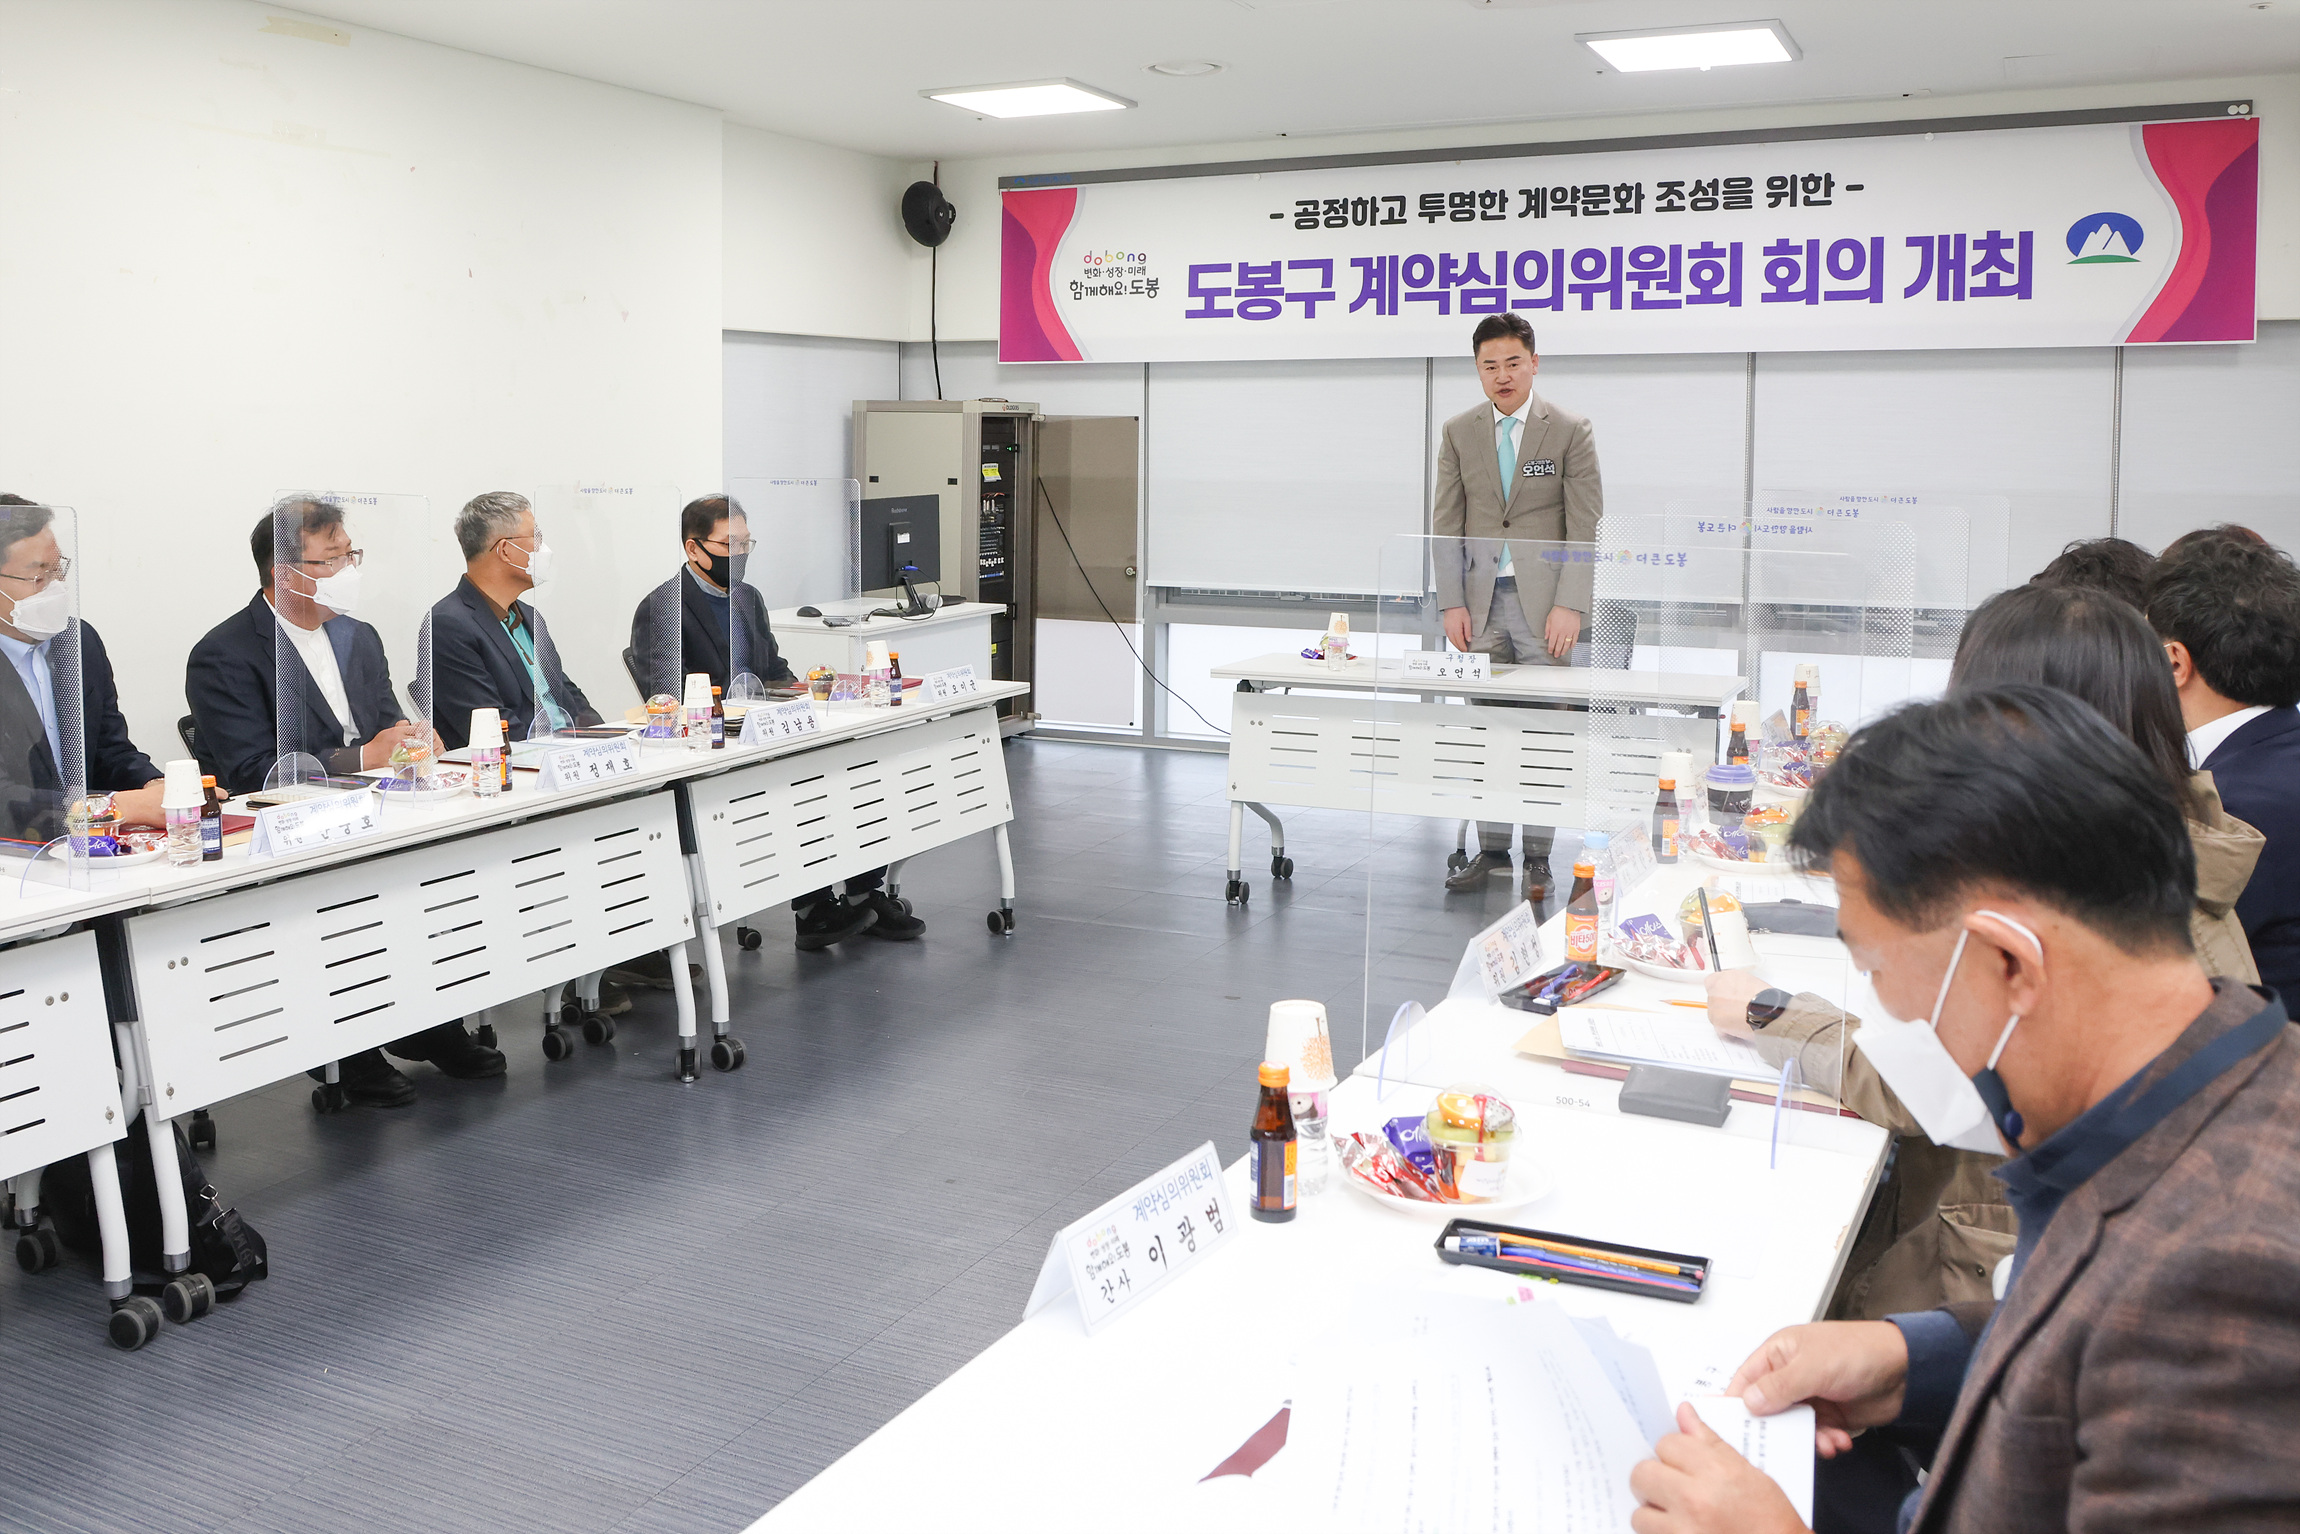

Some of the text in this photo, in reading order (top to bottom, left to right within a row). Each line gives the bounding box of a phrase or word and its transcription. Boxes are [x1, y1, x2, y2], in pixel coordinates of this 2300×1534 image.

[1294, 196, 1407, 230] 공정하고
[1418, 189, 1508, 223] 투명한
[1518, 182, 1645, 218] 계약문화
[1655, 177, 1753, 212] 조성을
[1766, 173, 1835, 208] 위한
[1084, 250, 1146, 265] dobong
[1185, 230, 2033, 320] 도봉구 계약심의위원회 회의 개최
[1070, 278, 1159, 301] 함께해요! 도봉
[1523, 464, 1556, 477] 오언석
[1636, 553, 1647, 564] 더
[1651, 553, 1661, 565] 큰
[1665, 552, 1687, 567] 도봉
[1132, 1158, 1214, 1222] 계약심의위원회
